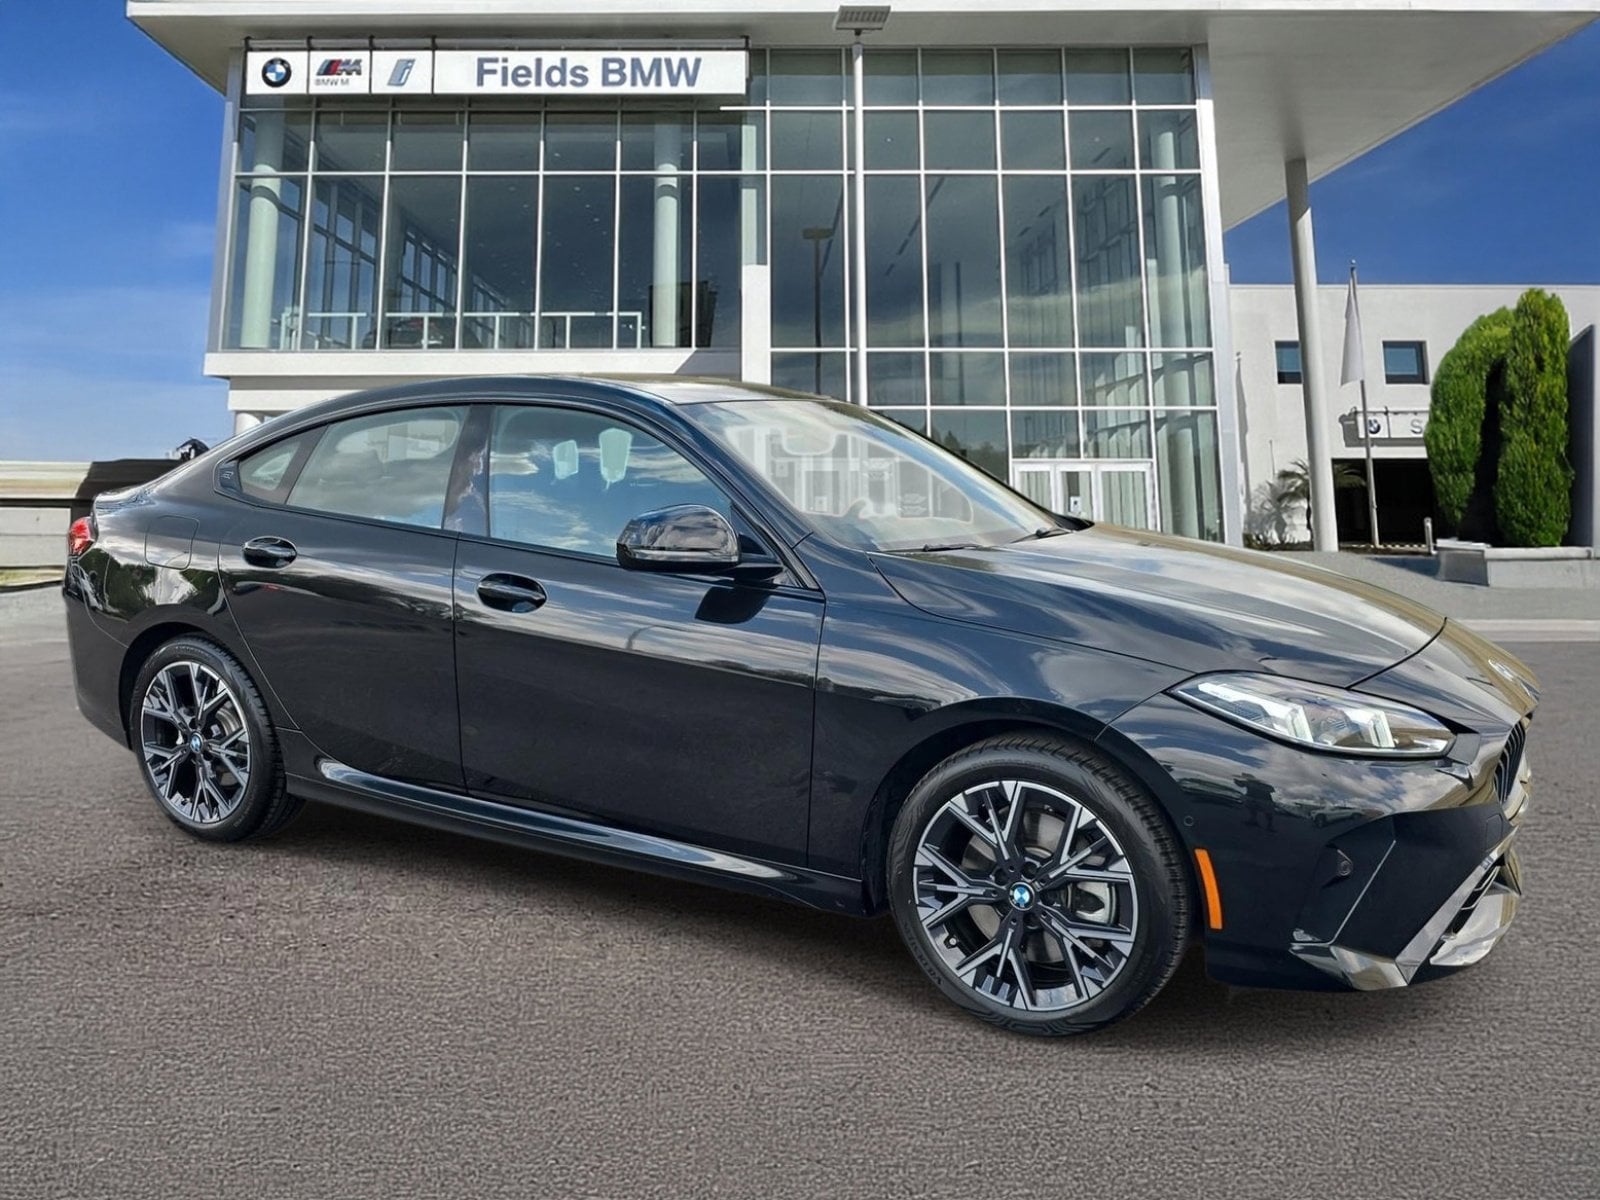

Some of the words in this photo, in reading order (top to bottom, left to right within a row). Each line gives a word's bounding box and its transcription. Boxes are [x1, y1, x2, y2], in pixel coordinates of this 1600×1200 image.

[315, 78, 338, 86] BMW
[476, 57, 589, 88] Fields
[601, 57, 702, 88] BMW
